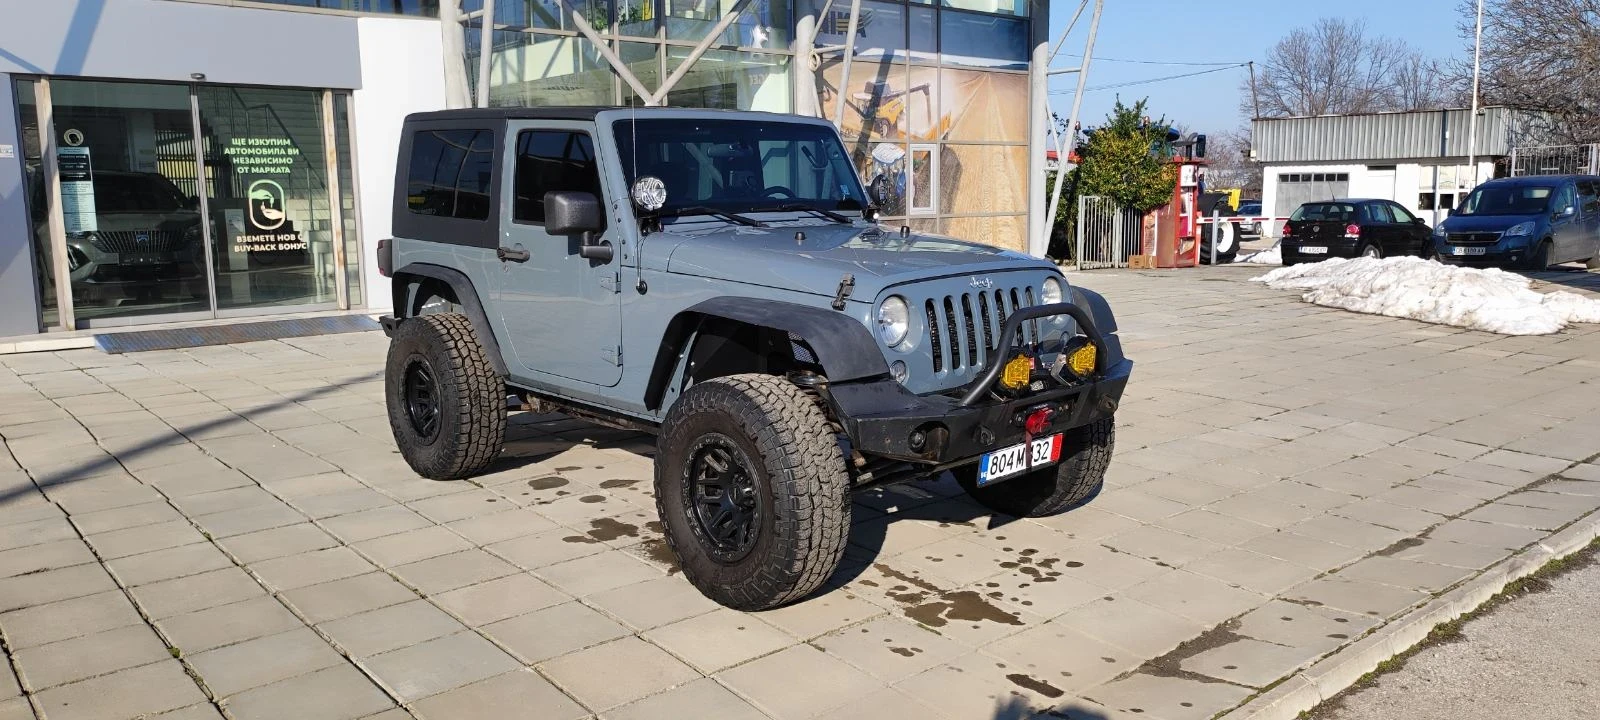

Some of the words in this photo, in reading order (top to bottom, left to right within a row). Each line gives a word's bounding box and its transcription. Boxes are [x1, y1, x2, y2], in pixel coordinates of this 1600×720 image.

[231, 138, 246, 146] ЩЕ
[248, 138, 291, 146] ИЗКУПИМ
[224, 147, 285, 155] АВТОМОБИЛА
[251, 166, 291, 174] МАРКАТА
[236, 235, 275, 243] ВЗЕМЕТЕ
[234, 244, 277, 252] BUY-BACK
[969, 276, 993, 289] Jeep
